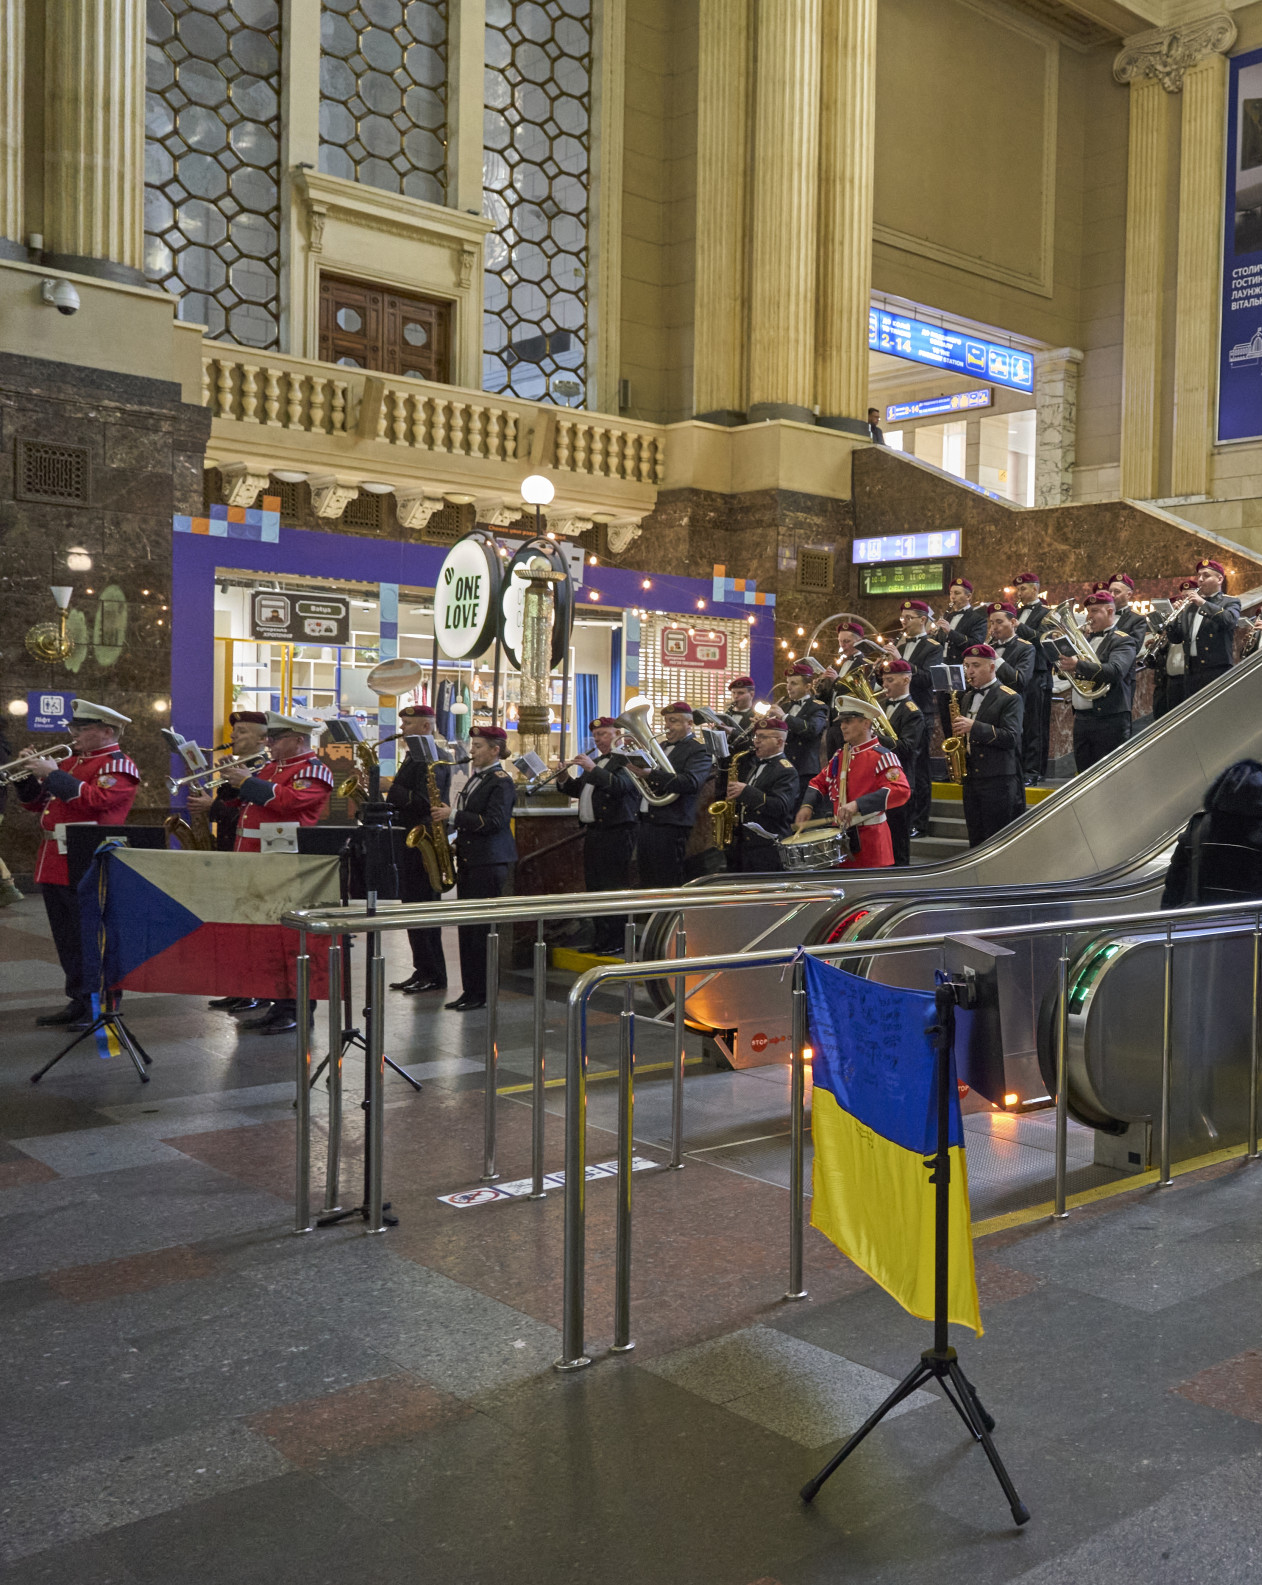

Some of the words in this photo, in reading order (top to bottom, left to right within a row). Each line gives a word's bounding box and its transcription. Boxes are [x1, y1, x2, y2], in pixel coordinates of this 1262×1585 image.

[881, 334, 912, 353] 2-14
[455, 575, 482, 602] ONE
[864, 577, 871, 593] 1
[444, 603, 479, 629] LOVE
[34, 716, 51, 724] Ліфт
[751, 1038, 768, 1046] STOP
